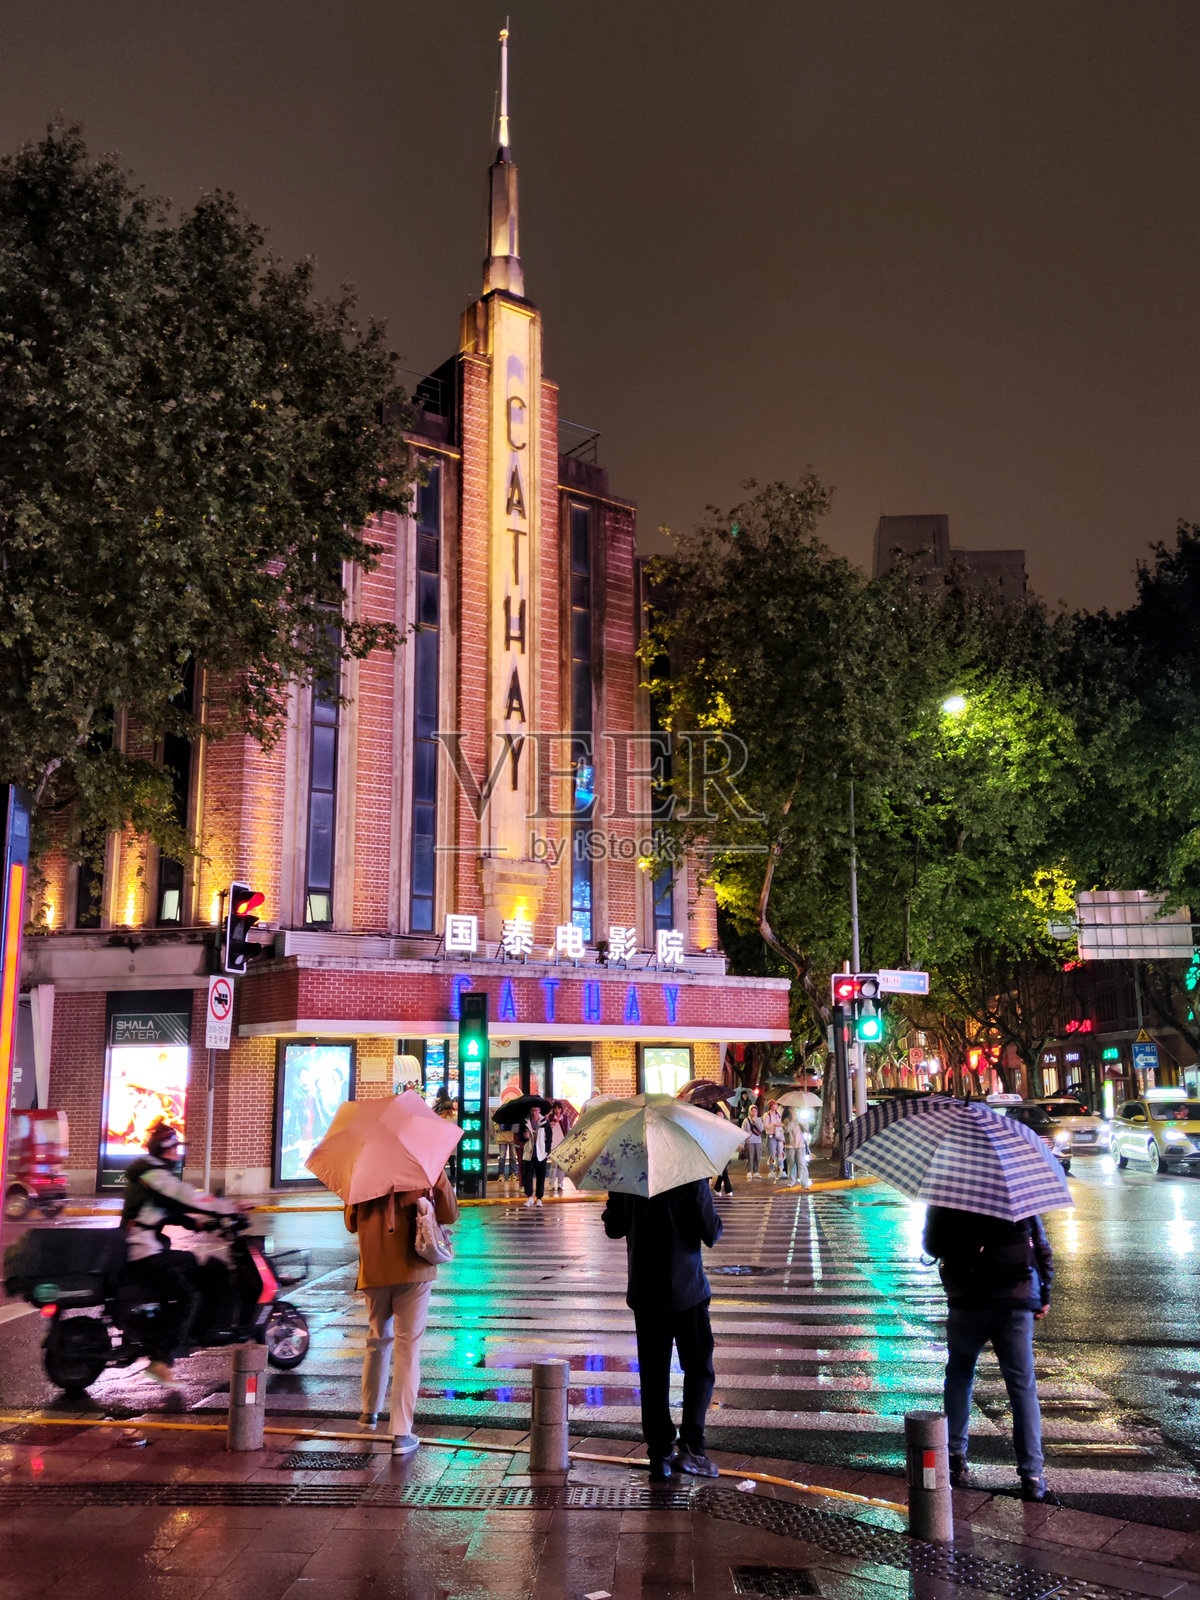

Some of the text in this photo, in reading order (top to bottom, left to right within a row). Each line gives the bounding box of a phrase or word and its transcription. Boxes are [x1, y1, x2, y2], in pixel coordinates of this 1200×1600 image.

[505, 395, 527, 791] CATHAY
[445, 914, 685, 964] 国泰电影院
[116, 1020, 154, 1029] SHALA
[115, 1030, 161, 1040] EATERY
[461, 1158, 481, 1171] 信号
